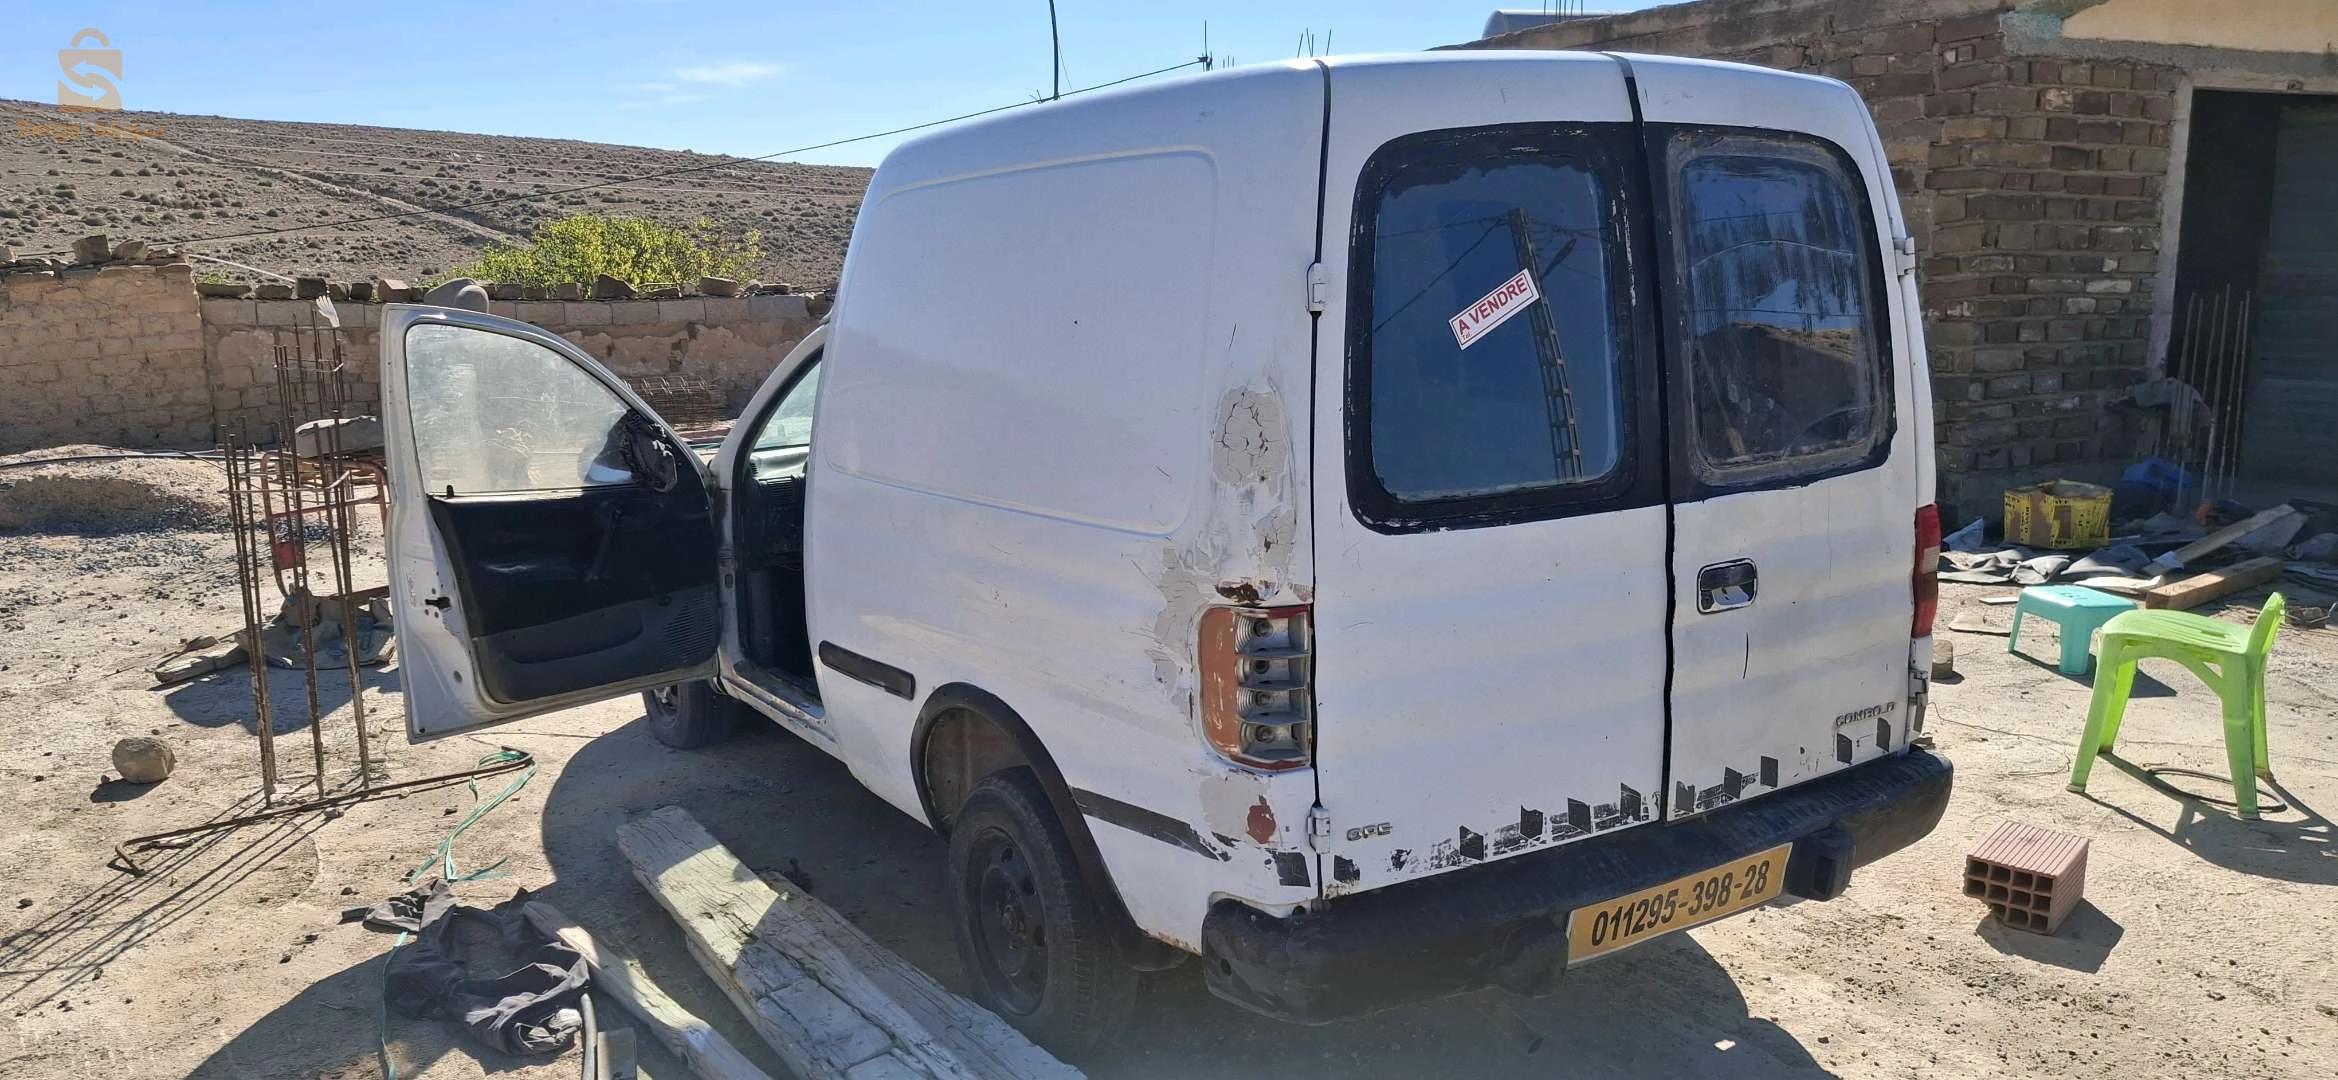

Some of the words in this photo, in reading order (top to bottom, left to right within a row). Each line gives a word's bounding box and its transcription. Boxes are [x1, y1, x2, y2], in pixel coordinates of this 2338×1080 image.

[1458, 318, 1471, 335] A
[1468, 277, 1528, 325] VENDRE
[1590, 859, 1771, 947] 011295-398-28
